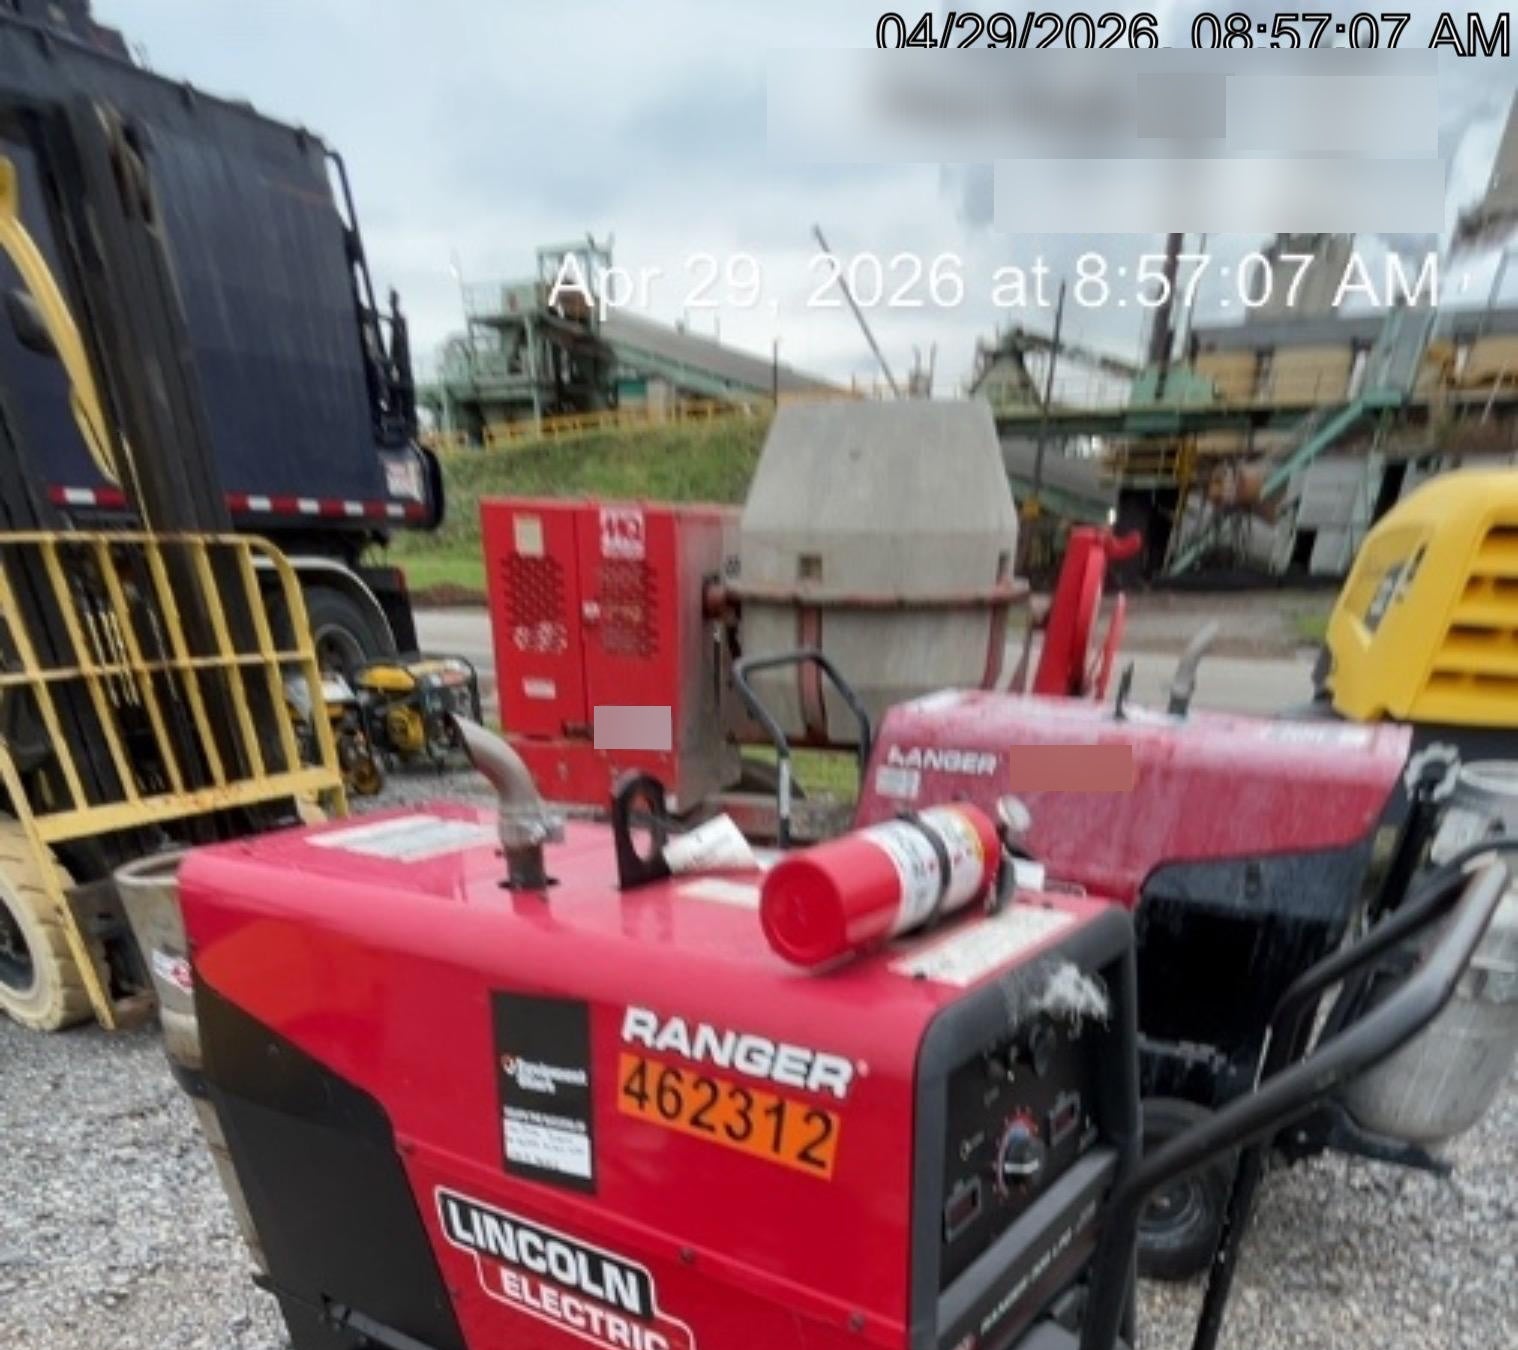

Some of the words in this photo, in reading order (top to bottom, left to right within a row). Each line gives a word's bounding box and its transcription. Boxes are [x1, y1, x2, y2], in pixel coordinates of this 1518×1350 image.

[622, 1005, 854, 1099] RANGER
[623, 1060, 833, 1168] 462312
[447, 1198, 642, 1315] LINCOLN
